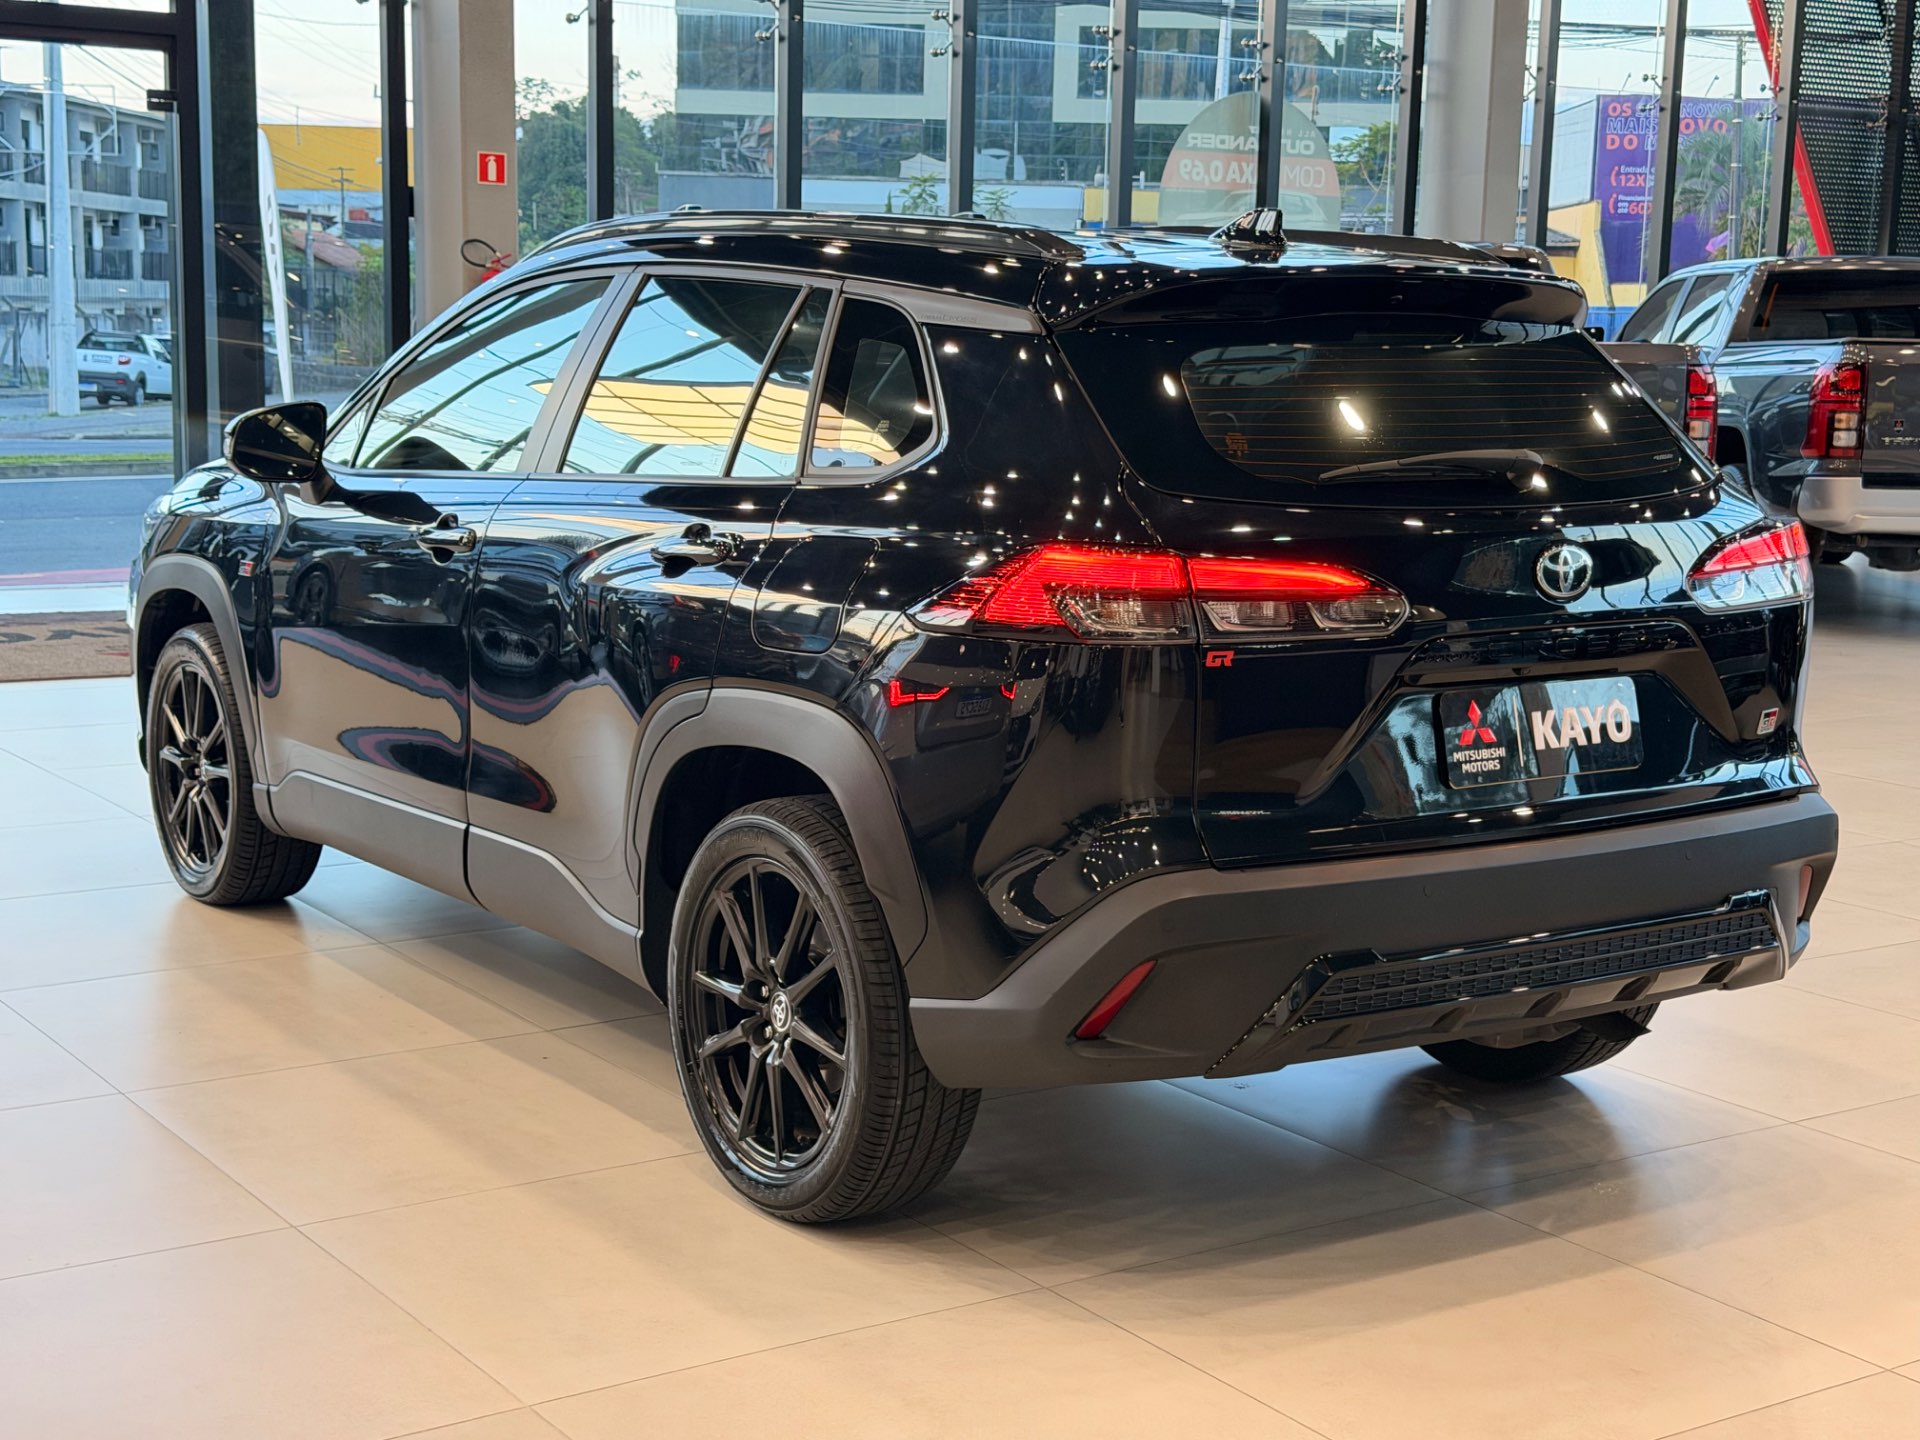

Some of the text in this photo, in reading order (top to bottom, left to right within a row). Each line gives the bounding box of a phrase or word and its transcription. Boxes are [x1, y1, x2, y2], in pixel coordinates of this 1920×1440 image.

[1607, 102, 1632, 117] OS
[1606, 117, 1658, 134] MAIS
[1606, 134, 1638, 150] DO
[1619, 174, 1646, 187] 12X
[1205, 650, 1235, 668] GR
[1453, 746, 1506, 763] MITSUBISHI
[1462, 759, 1501, 774] MOTORS
